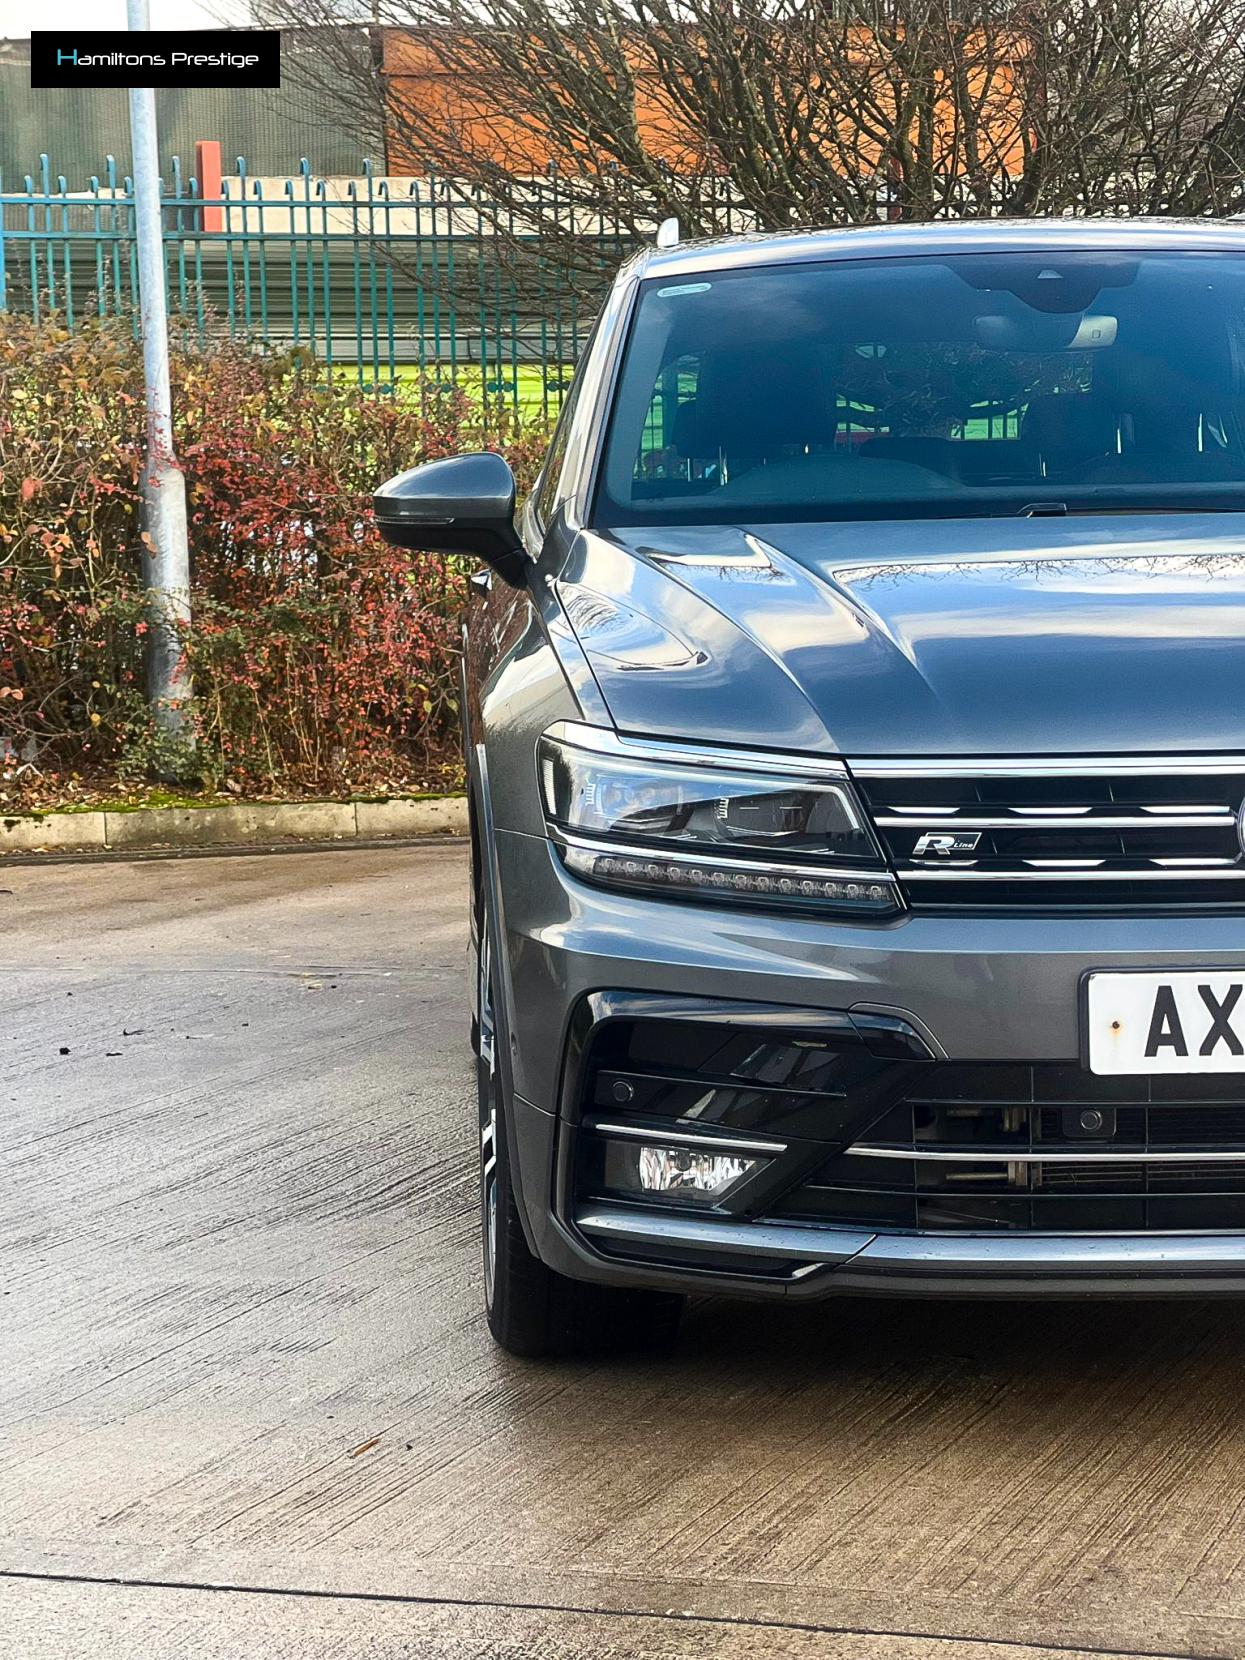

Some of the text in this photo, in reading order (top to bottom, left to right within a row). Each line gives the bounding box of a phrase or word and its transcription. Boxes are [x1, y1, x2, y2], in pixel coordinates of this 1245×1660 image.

[912, 835, 974, 855] R Line
[1144, 984, 1244, 1057] AX
